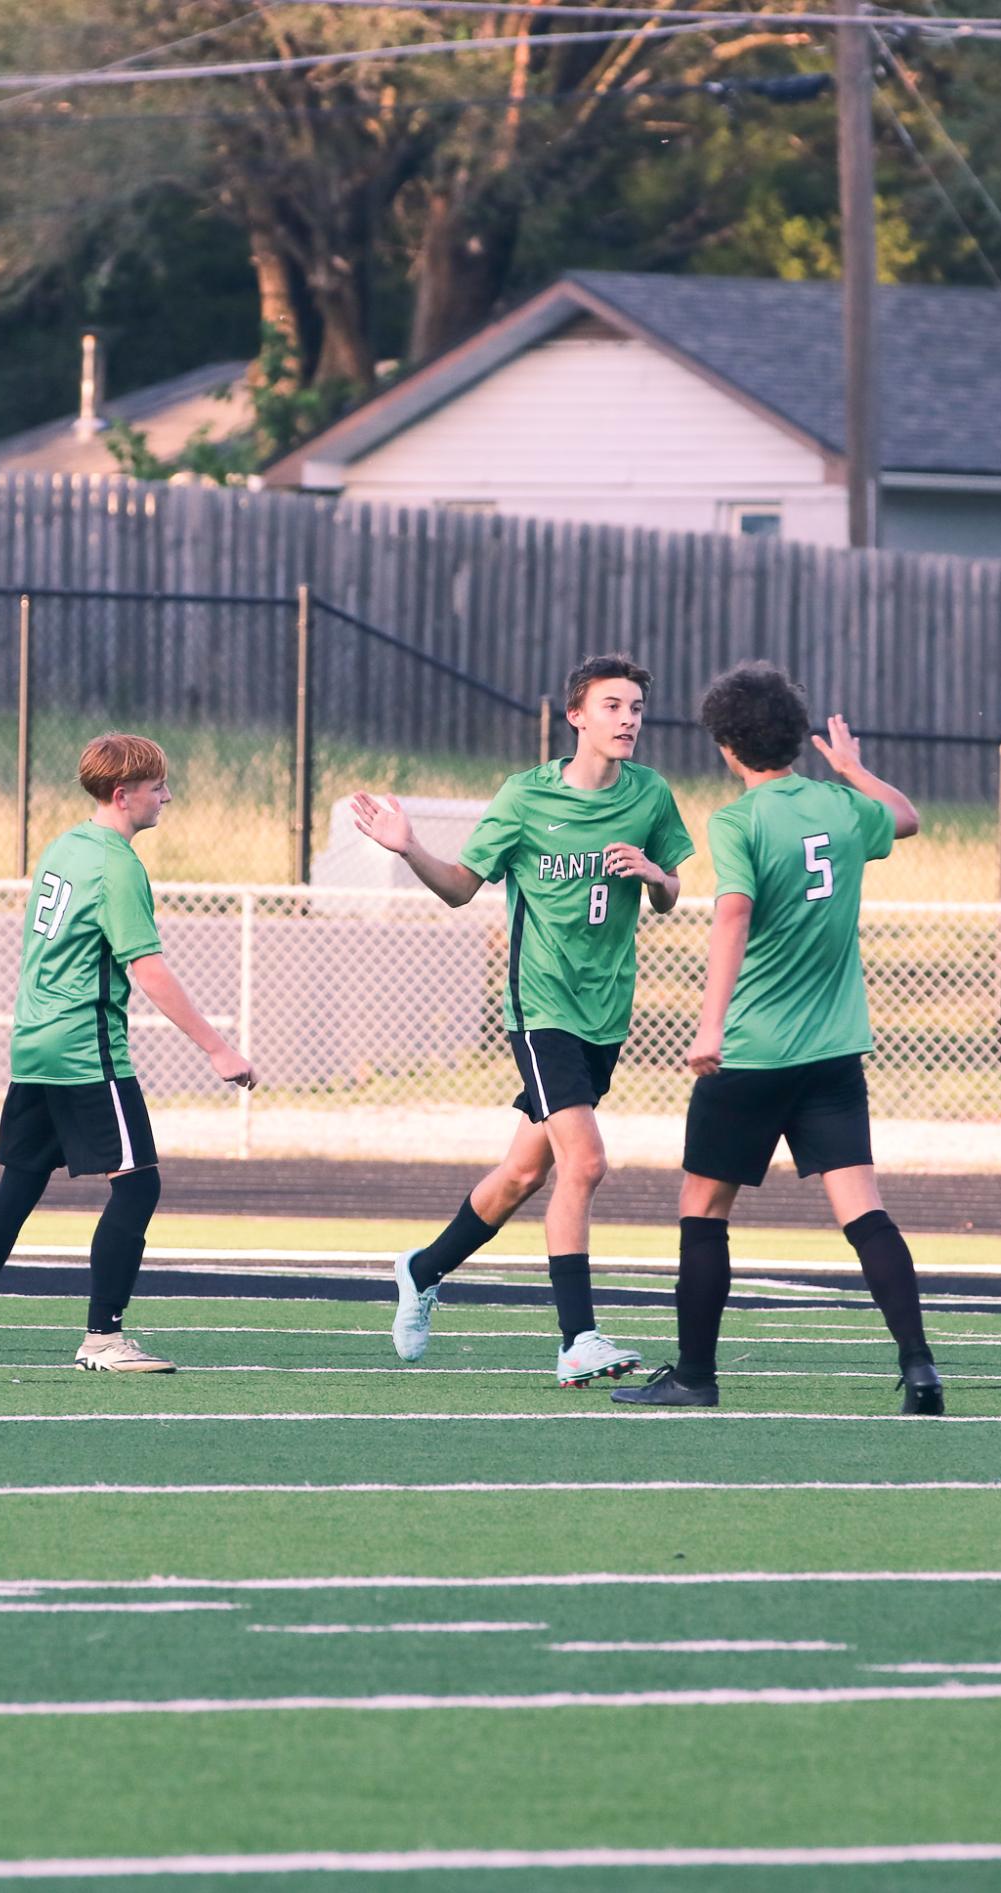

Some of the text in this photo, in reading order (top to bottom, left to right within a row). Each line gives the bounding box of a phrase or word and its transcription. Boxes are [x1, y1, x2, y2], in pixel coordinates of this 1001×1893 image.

[801, 832, 834, 902] 5
[33, 871, 73, 941] 21
[588, 883, 609, 926] 8
